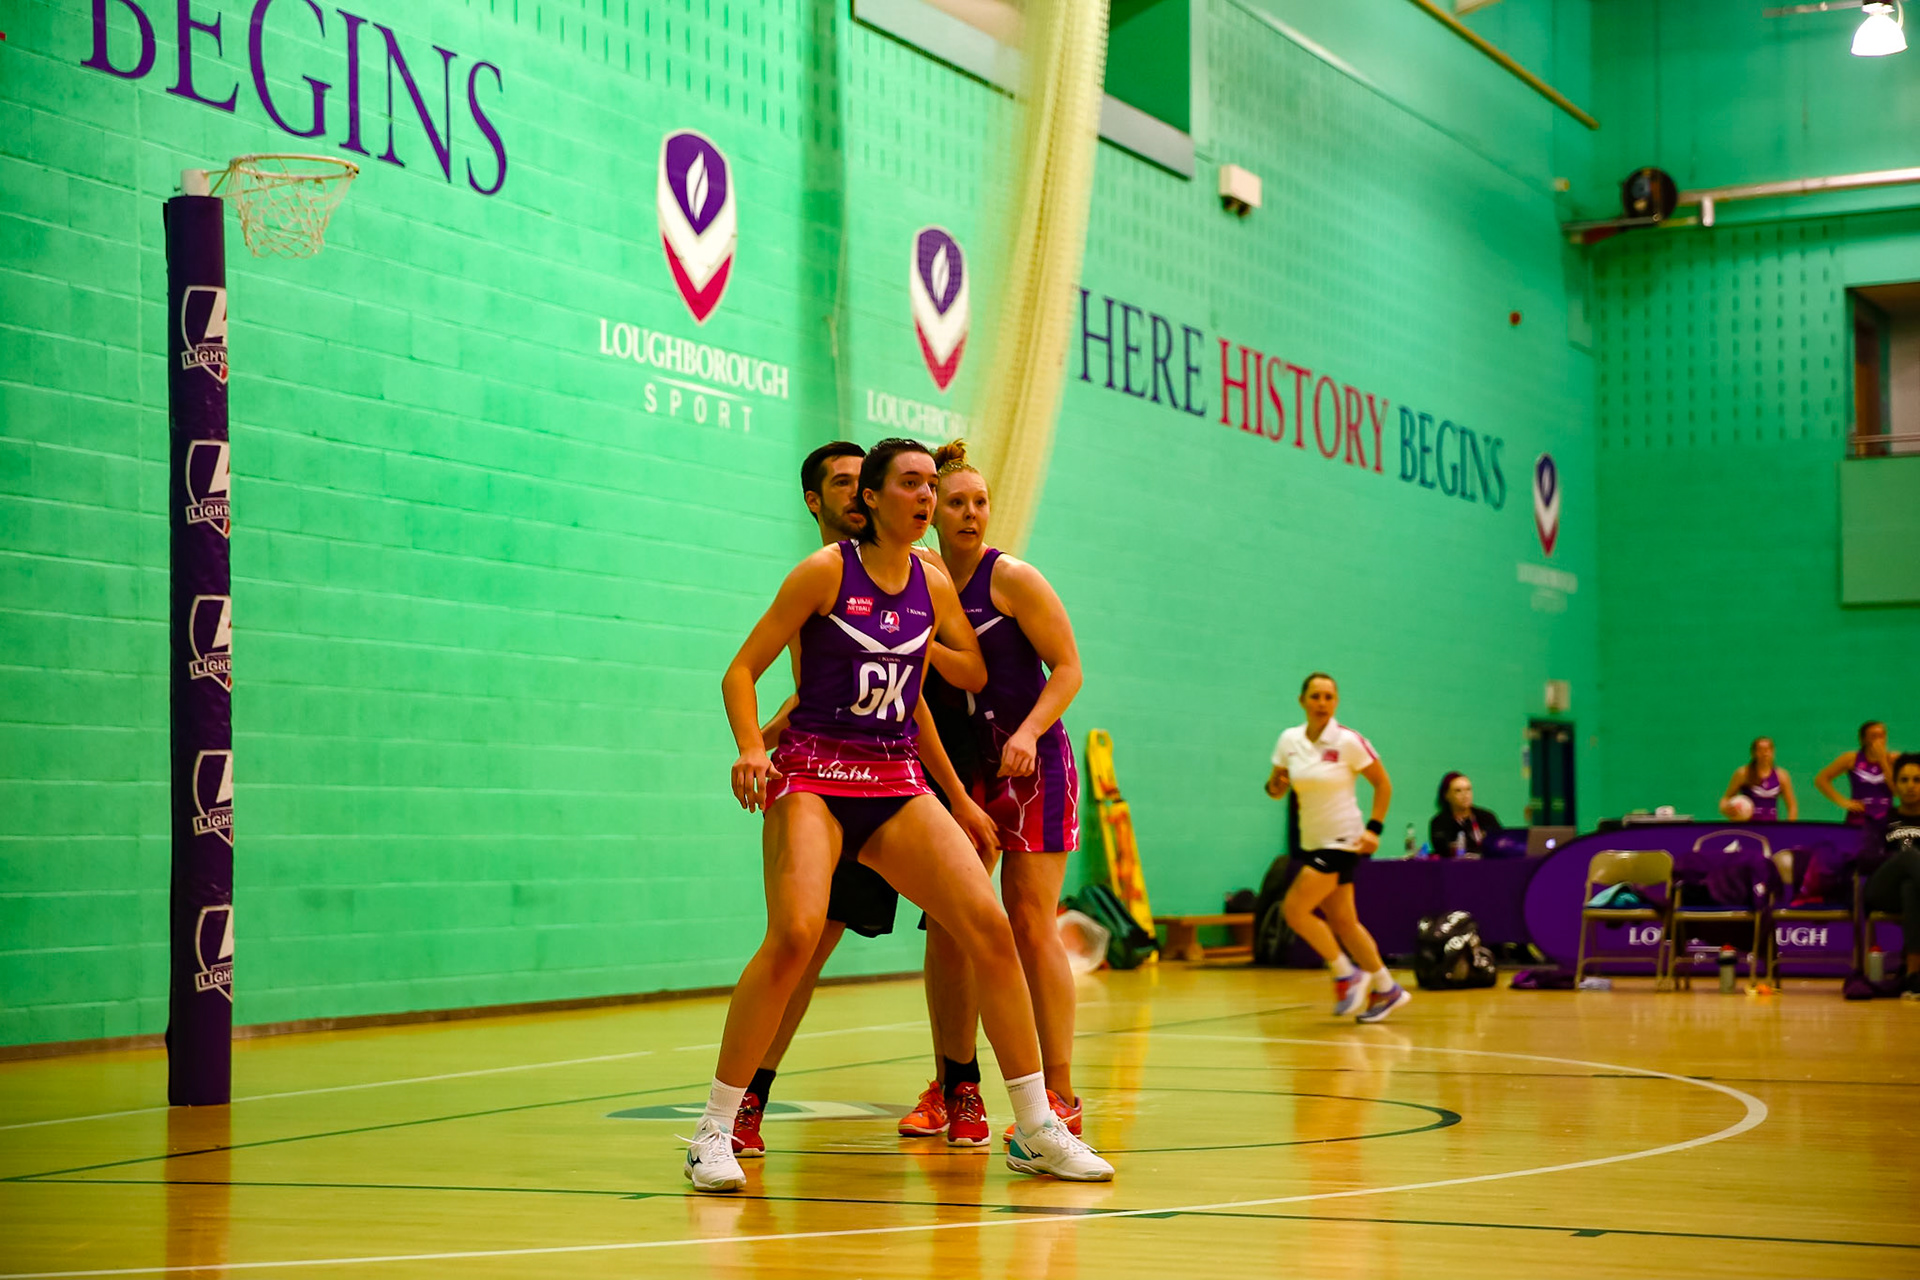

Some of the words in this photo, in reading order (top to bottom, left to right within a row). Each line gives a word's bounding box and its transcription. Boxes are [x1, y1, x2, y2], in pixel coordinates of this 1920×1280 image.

[186, 350, 227, 364] LIGHT
[600, 318, 789, 400] LOUGHBOROUGH
[644, 382, 753, 433] SPORT
[1079, 285, 1207, 417] HERE
[1217, 336, 1389, 474] HISTORY
[1398, 404, 1506, 511] BEGINS
[190, 505, 230, 519] LIGHT
[194, 660, 232, 674] LIGHT
[849, 661, 914, 722] GK
